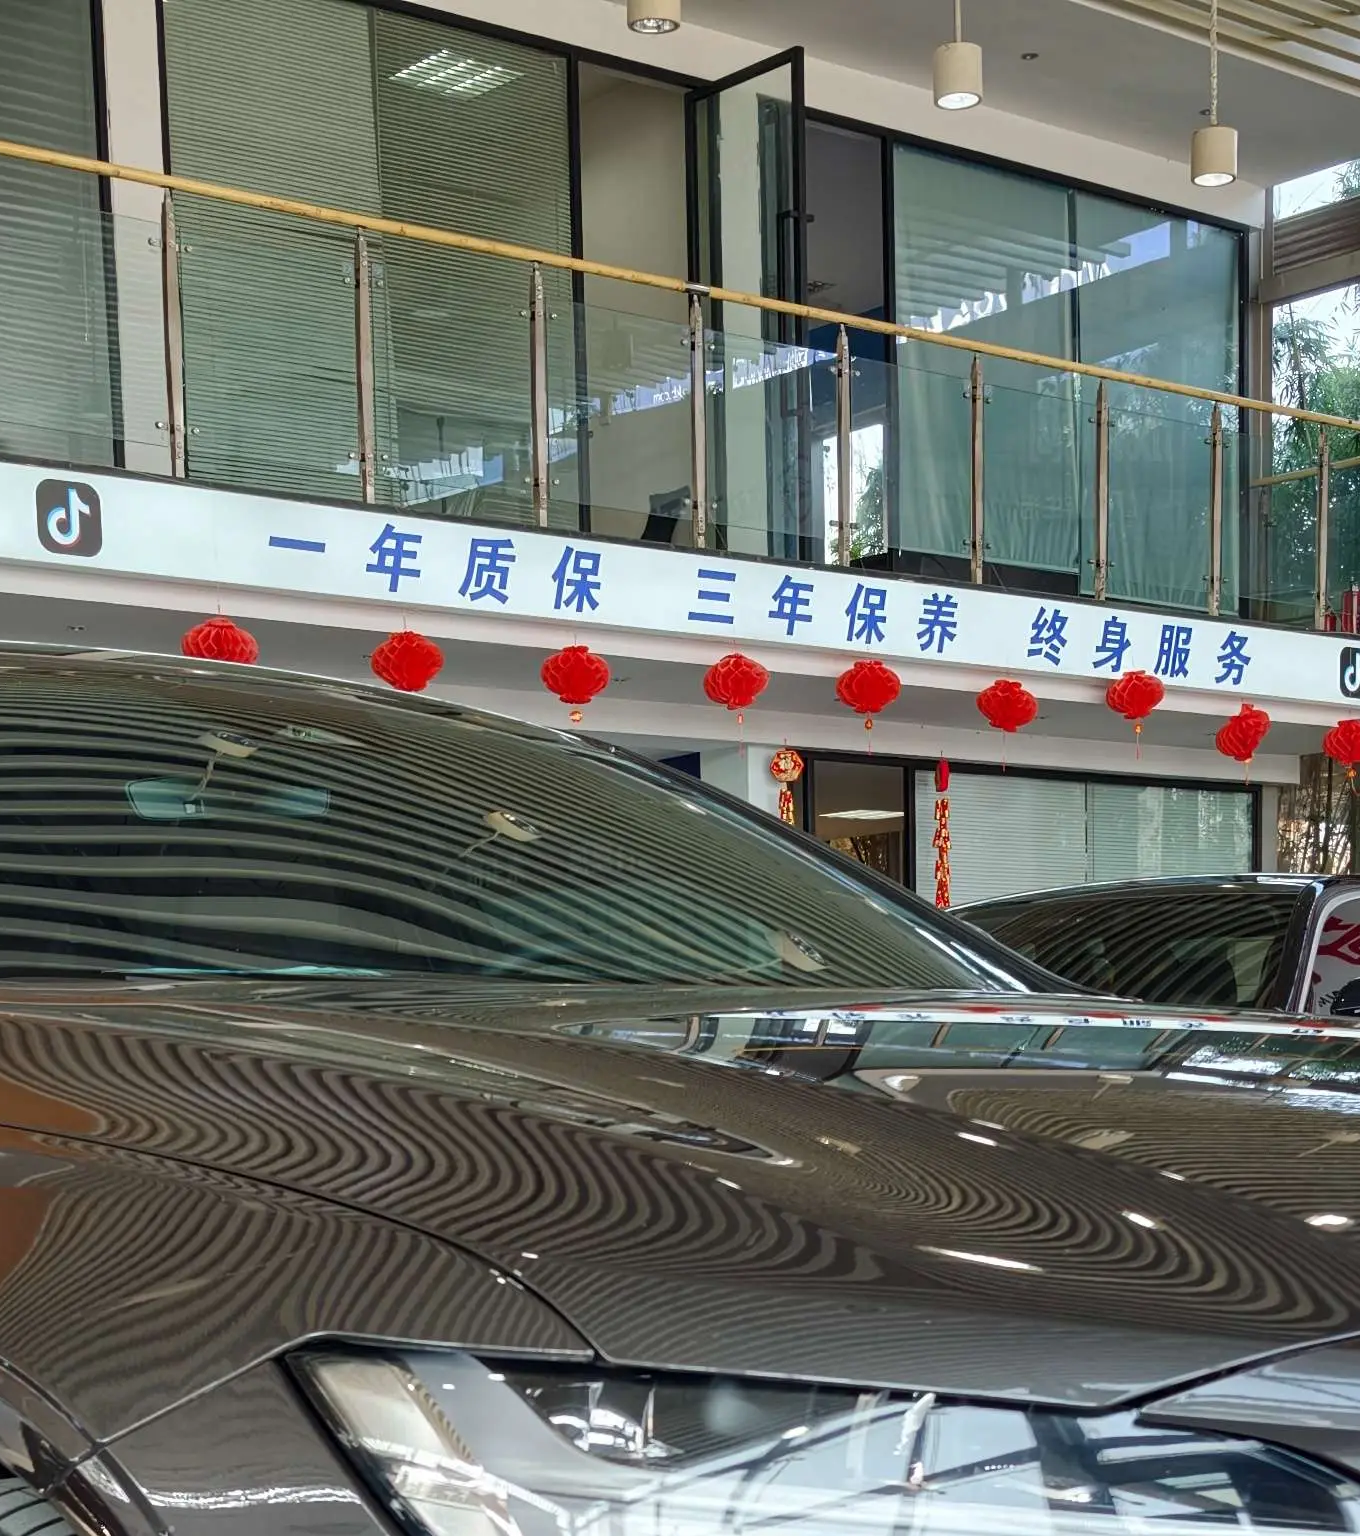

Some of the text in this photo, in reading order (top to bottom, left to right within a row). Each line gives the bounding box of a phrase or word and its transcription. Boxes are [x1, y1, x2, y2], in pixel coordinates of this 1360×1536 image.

[268, 524, 1252, 687] 一年质保 三年保养 终身服务
